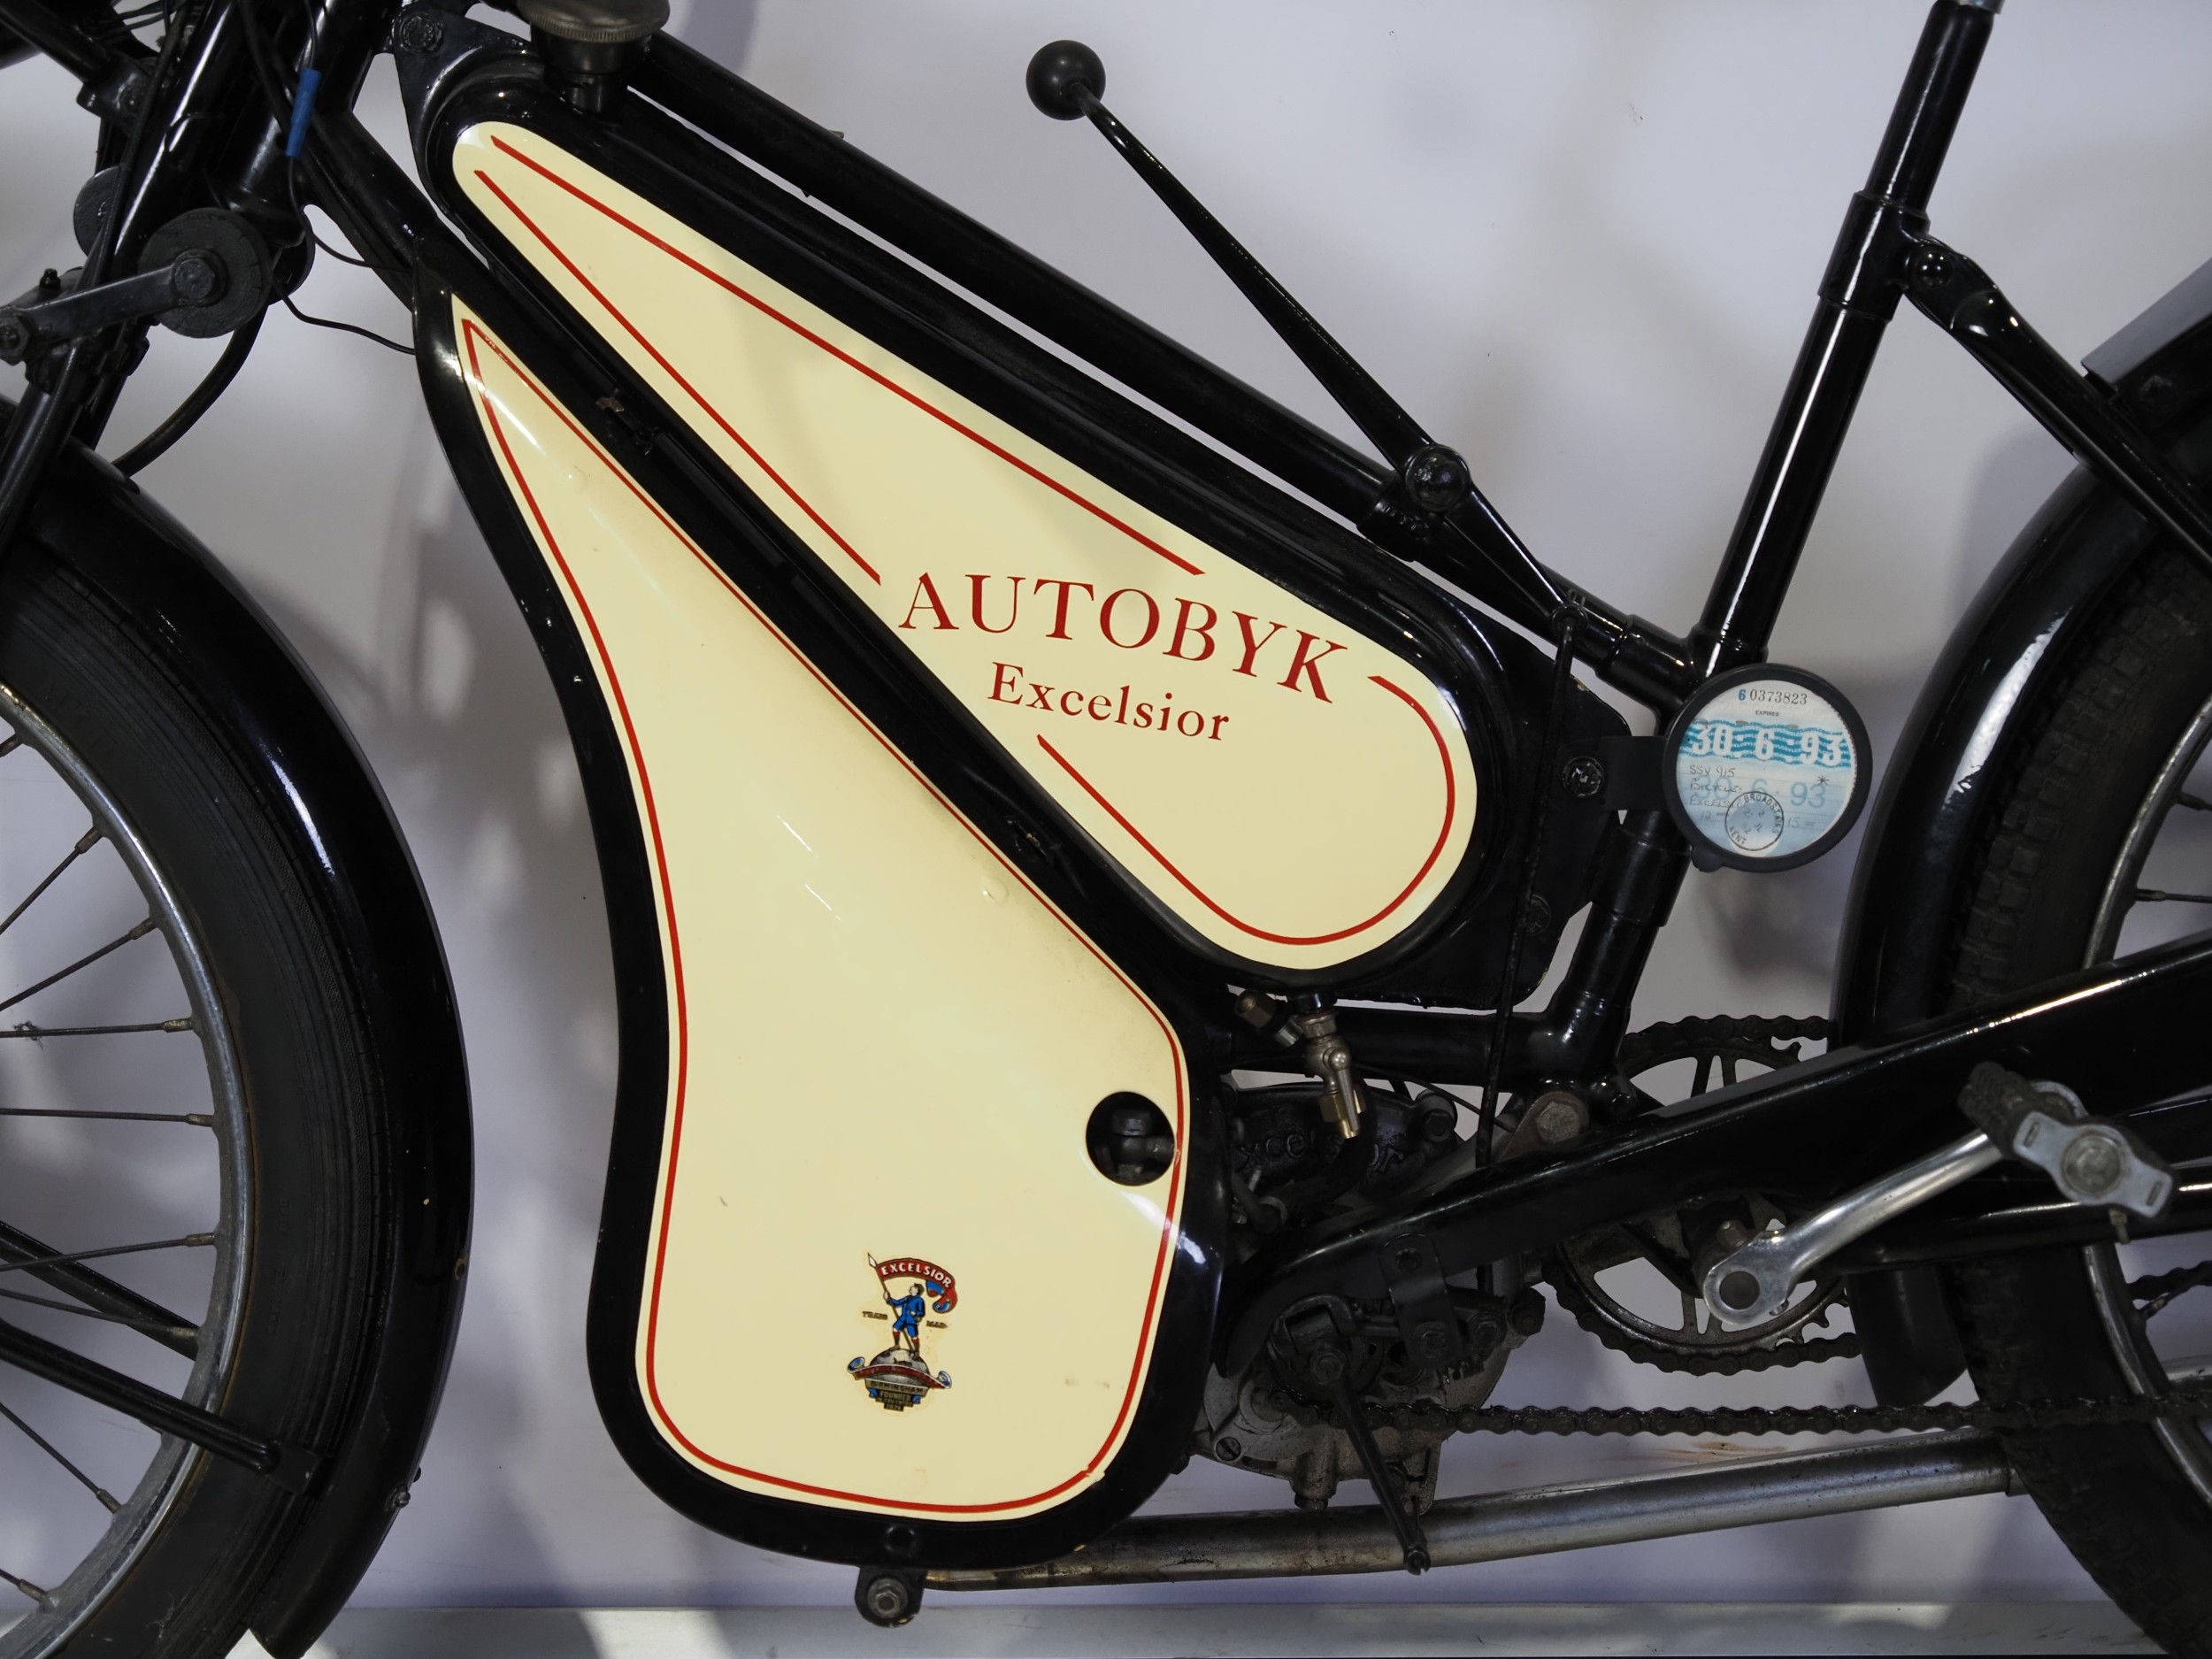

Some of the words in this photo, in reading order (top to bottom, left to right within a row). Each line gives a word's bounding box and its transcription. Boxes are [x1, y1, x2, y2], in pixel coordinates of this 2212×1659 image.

[898, 572, 1348, 703] AUTOBYK
[987, 662, 1230, 741] Excelsior
[880, 1263, 952, 1288] EXCELSIOR
[870, 1380, 924, 1394] BIRMINGHAM
